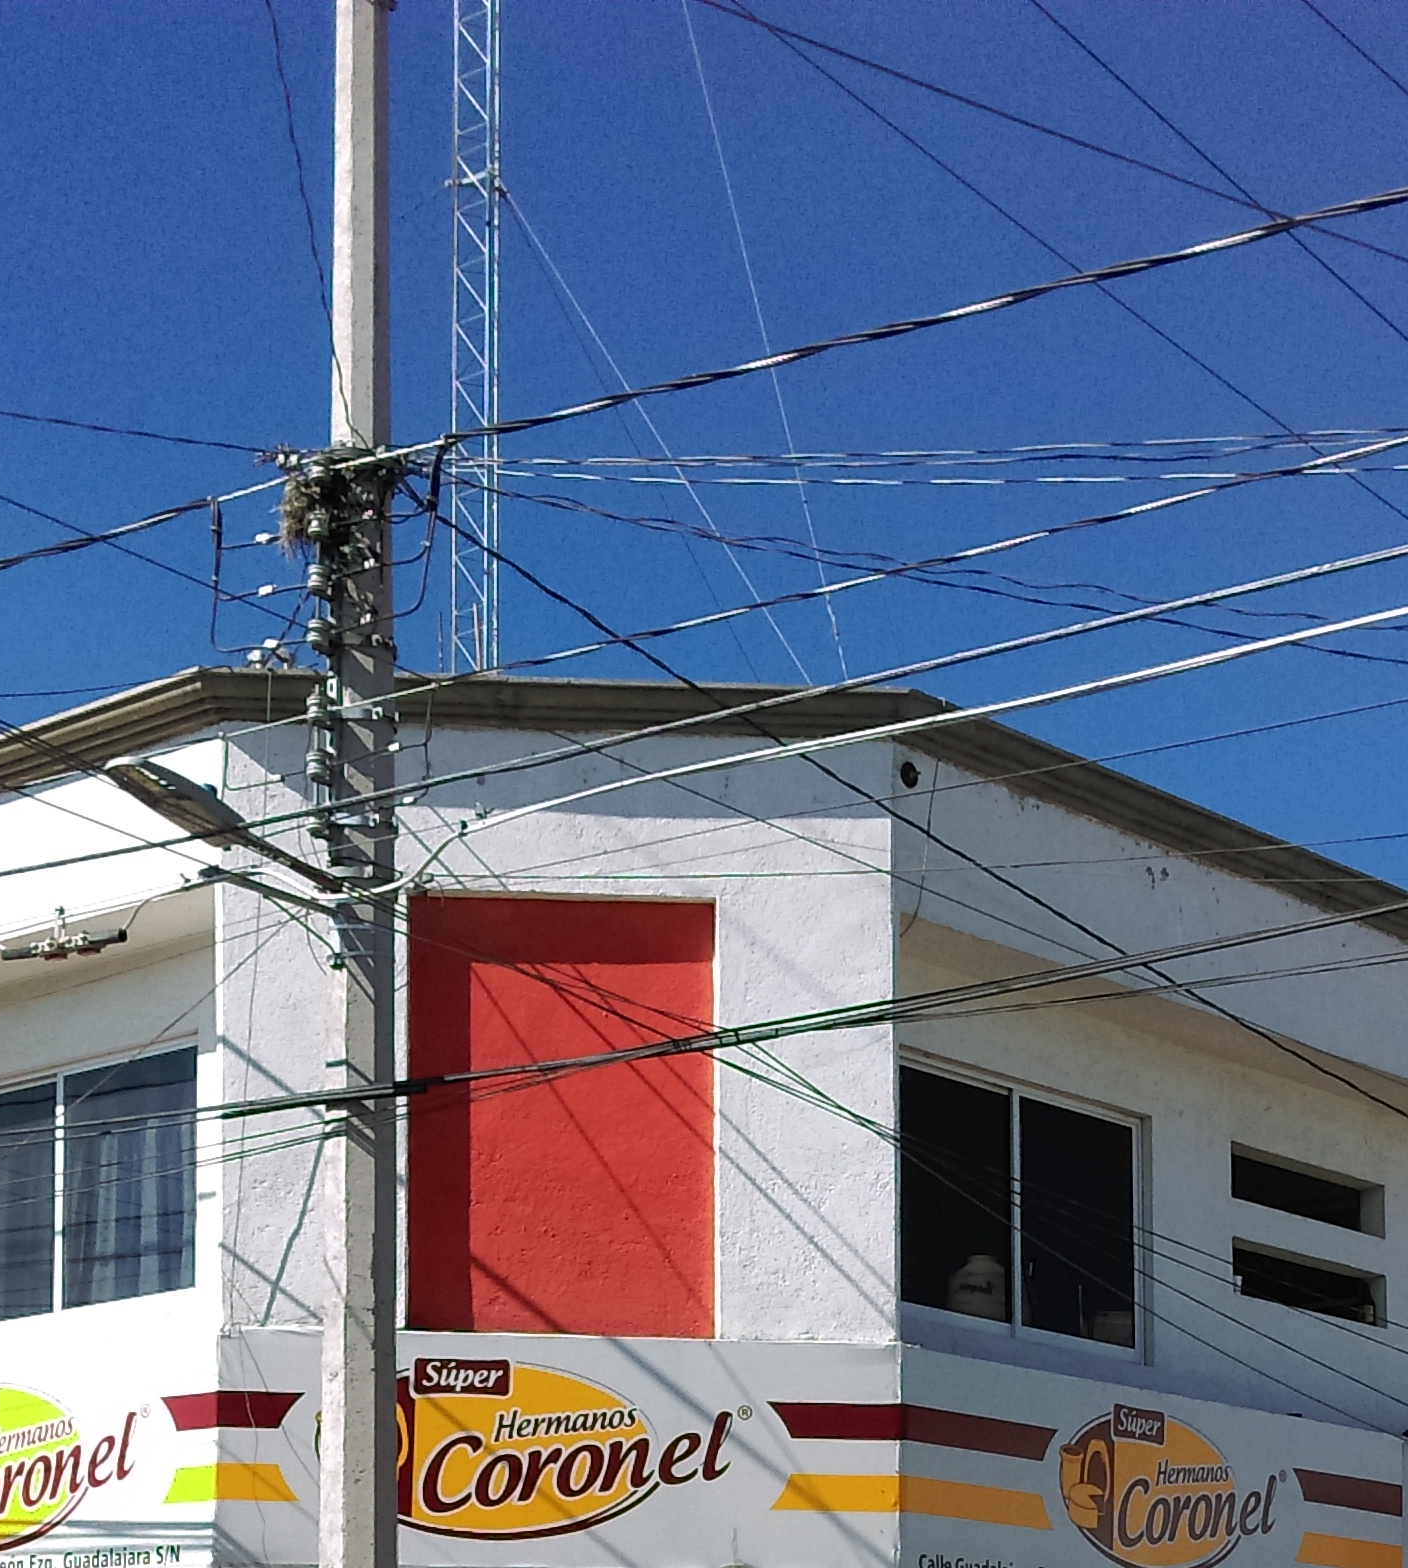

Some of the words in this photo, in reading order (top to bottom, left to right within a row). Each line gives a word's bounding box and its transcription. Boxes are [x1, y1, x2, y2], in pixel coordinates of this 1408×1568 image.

[422, 1361, 504, 1391] Súper
[494, 1407, 638, 1442] Hermanos
[1117, 1408, 1161, 1438] Súper
[422, 1411, 733, 1513] Coronel
[1155, 1459, 1230, 1487] Hermanos
[1117, 1474, 1277, 1548] Coronel
[156, 1545, 181, 1564] S/N
